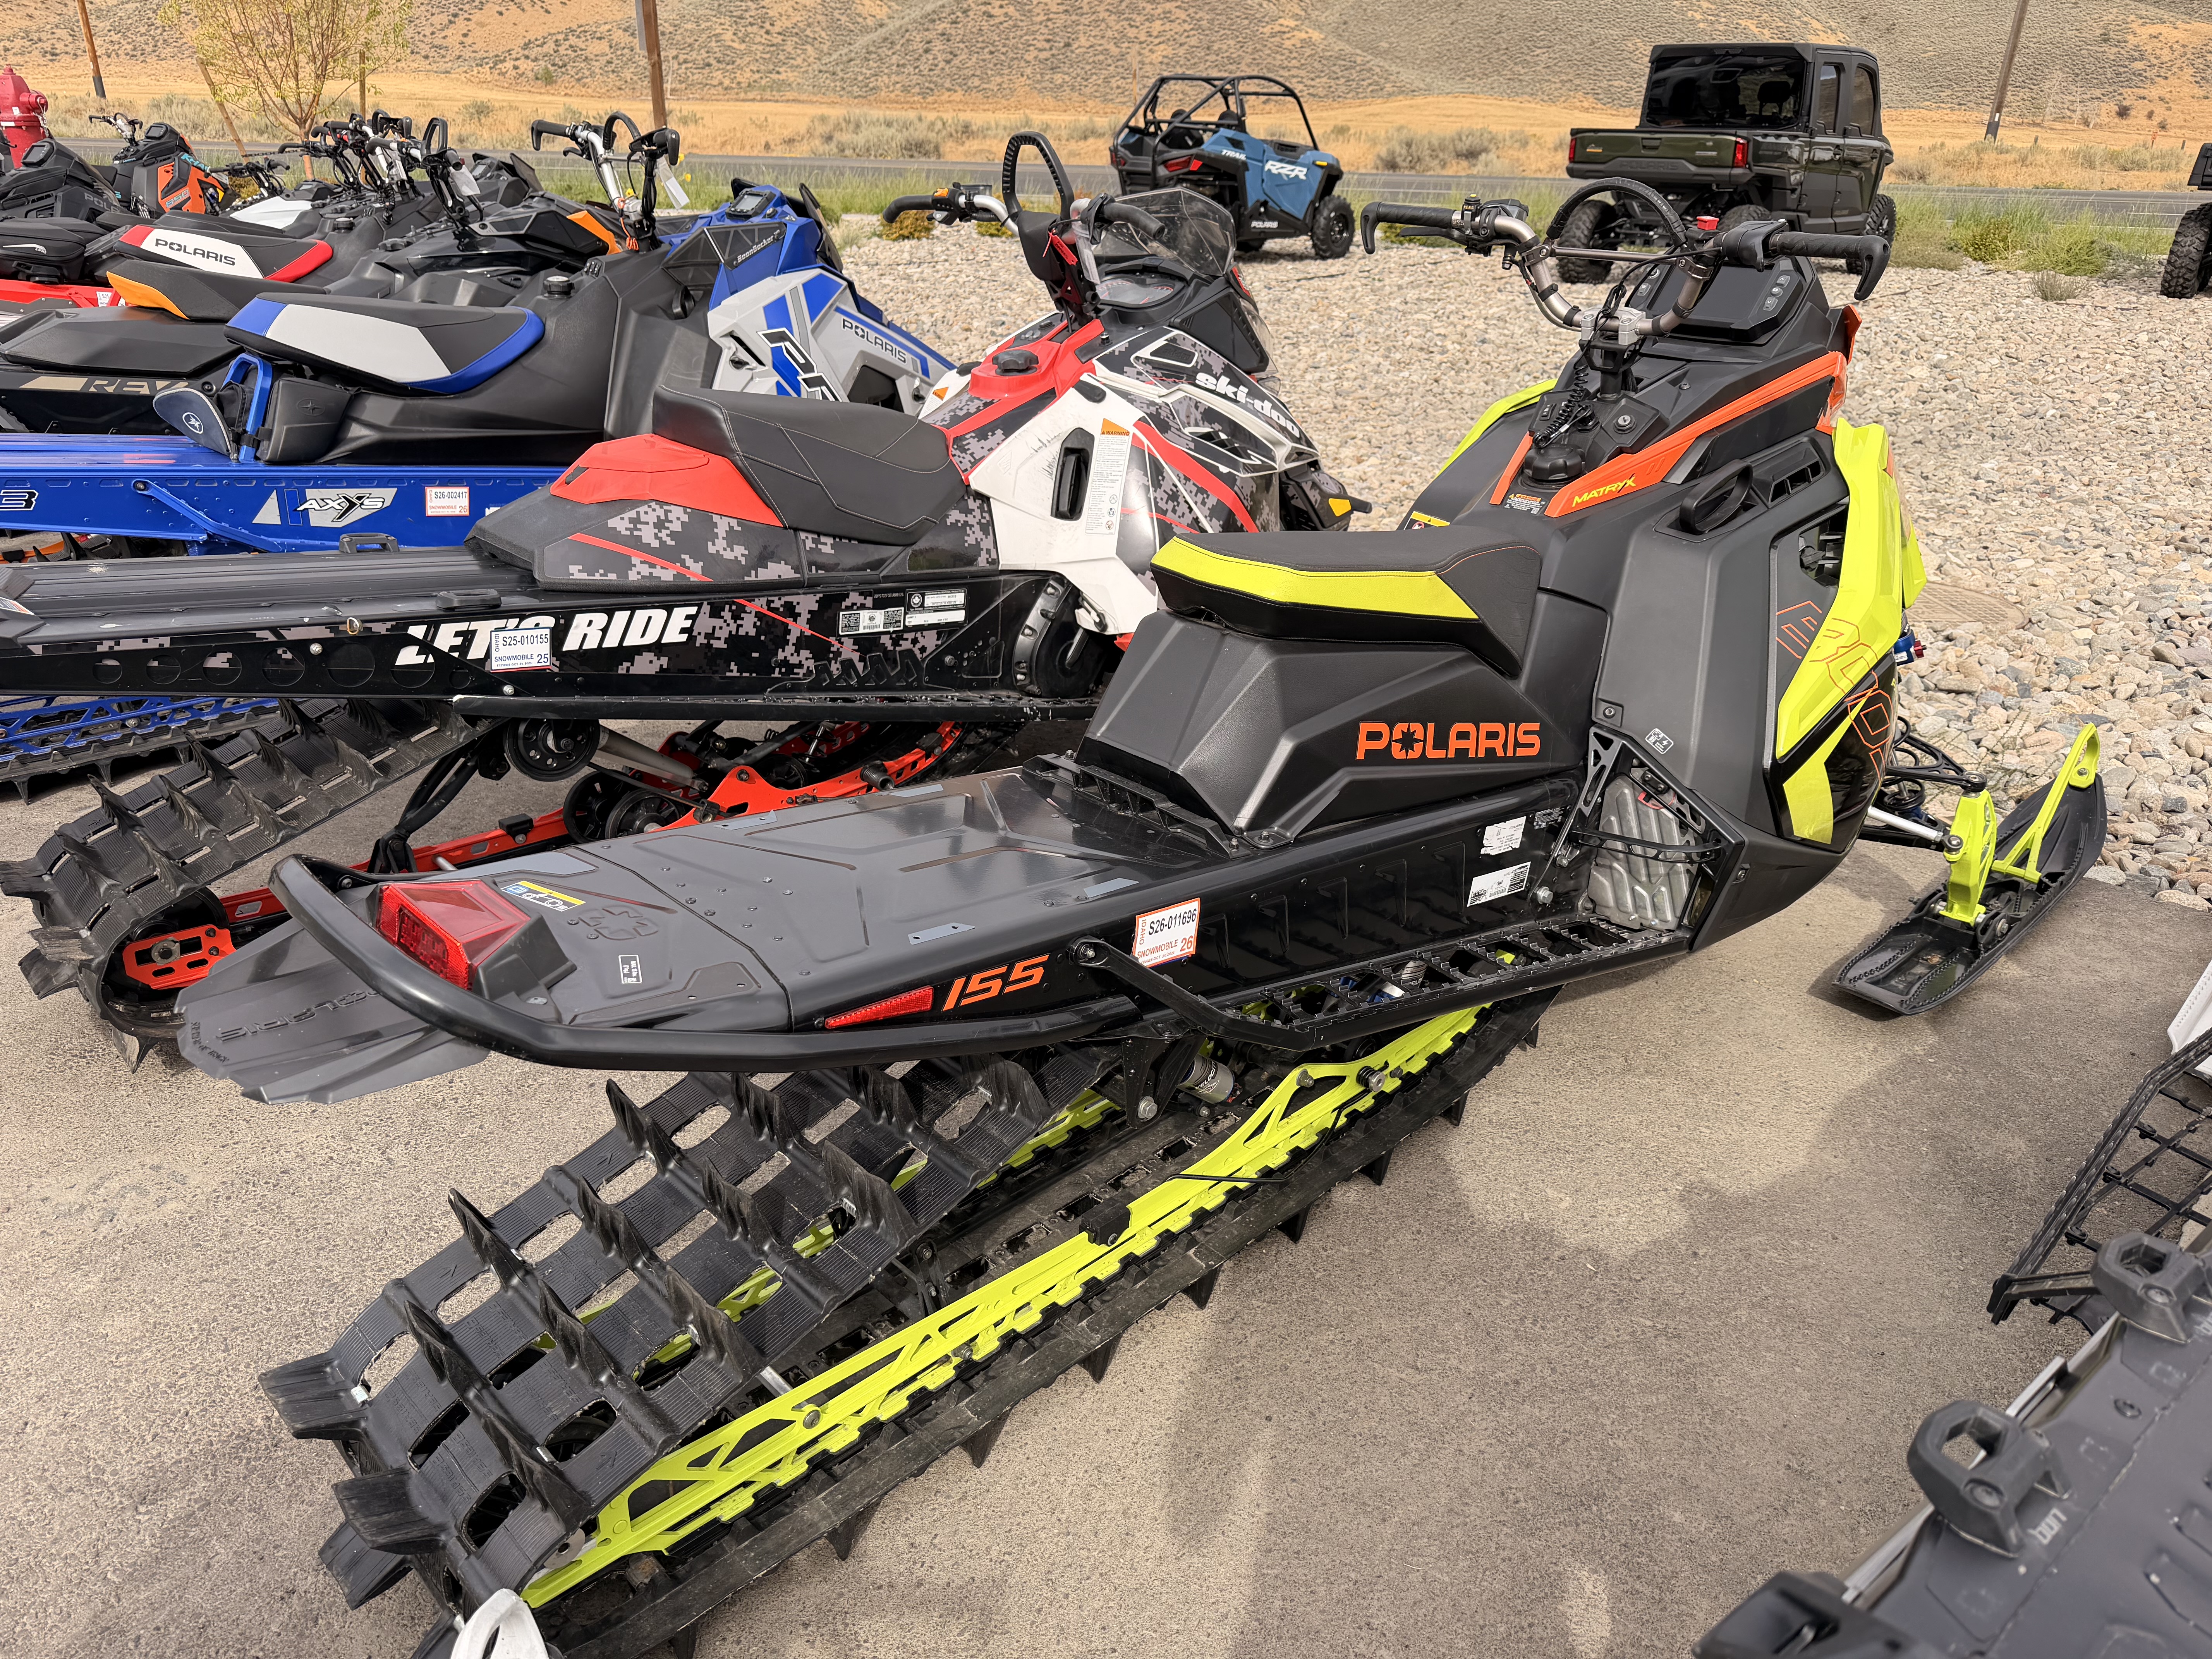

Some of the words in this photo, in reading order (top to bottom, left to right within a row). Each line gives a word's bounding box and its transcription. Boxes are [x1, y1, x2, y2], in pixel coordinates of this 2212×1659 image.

[1221, 149, 1246, 160] TRAIL
[1265, 160, 1307, 180] RZR
[155, 239, 235, 266] POLARIS
[843, 318, 907, 364] POLARIS
[1195, 372, 1300, 438] ski-doo
[1572, 474, 1637, 507] MATRYX
[293, 493, 385, 522] AXYS
[502, 634, 548, 646] S25-010155
[563, 606, 698, 651] RIDE
[495, 654, 534, 662] SNOWMOBILE
[537, 653, 548, 664] 25
[1356, 721, 1540, 760] POLARIS
[1149, 908, 1197, 935] S26-011696
[1137, 939, 1178, 959] SNOWMOBILE
[1180, 935, 1193, 952] 26
[942, 953, 1051, 1012] 155
